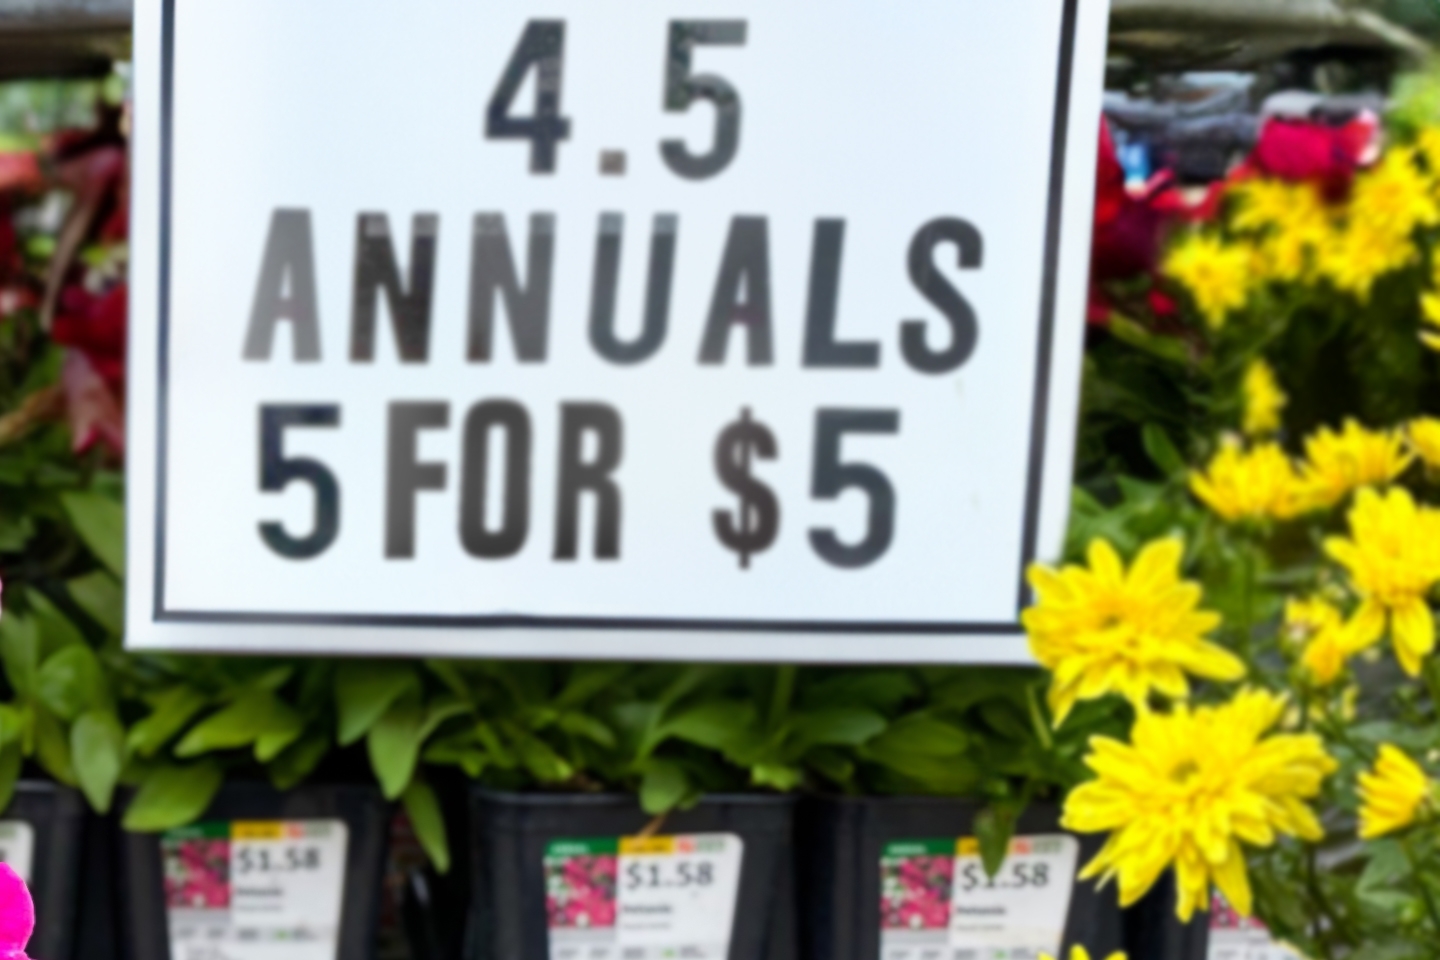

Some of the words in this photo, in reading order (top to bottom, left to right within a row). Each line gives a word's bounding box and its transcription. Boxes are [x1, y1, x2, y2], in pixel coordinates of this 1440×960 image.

[483, 18, 749, 181] 4.5
[240, 206, 985, 376] ANNUALS
[382, 396, 625, 563] FOR
[710, 404, 901, 571] $5
[238, 848, 320, 873] $1.58
[626, 860, 714, 890] $1.58
